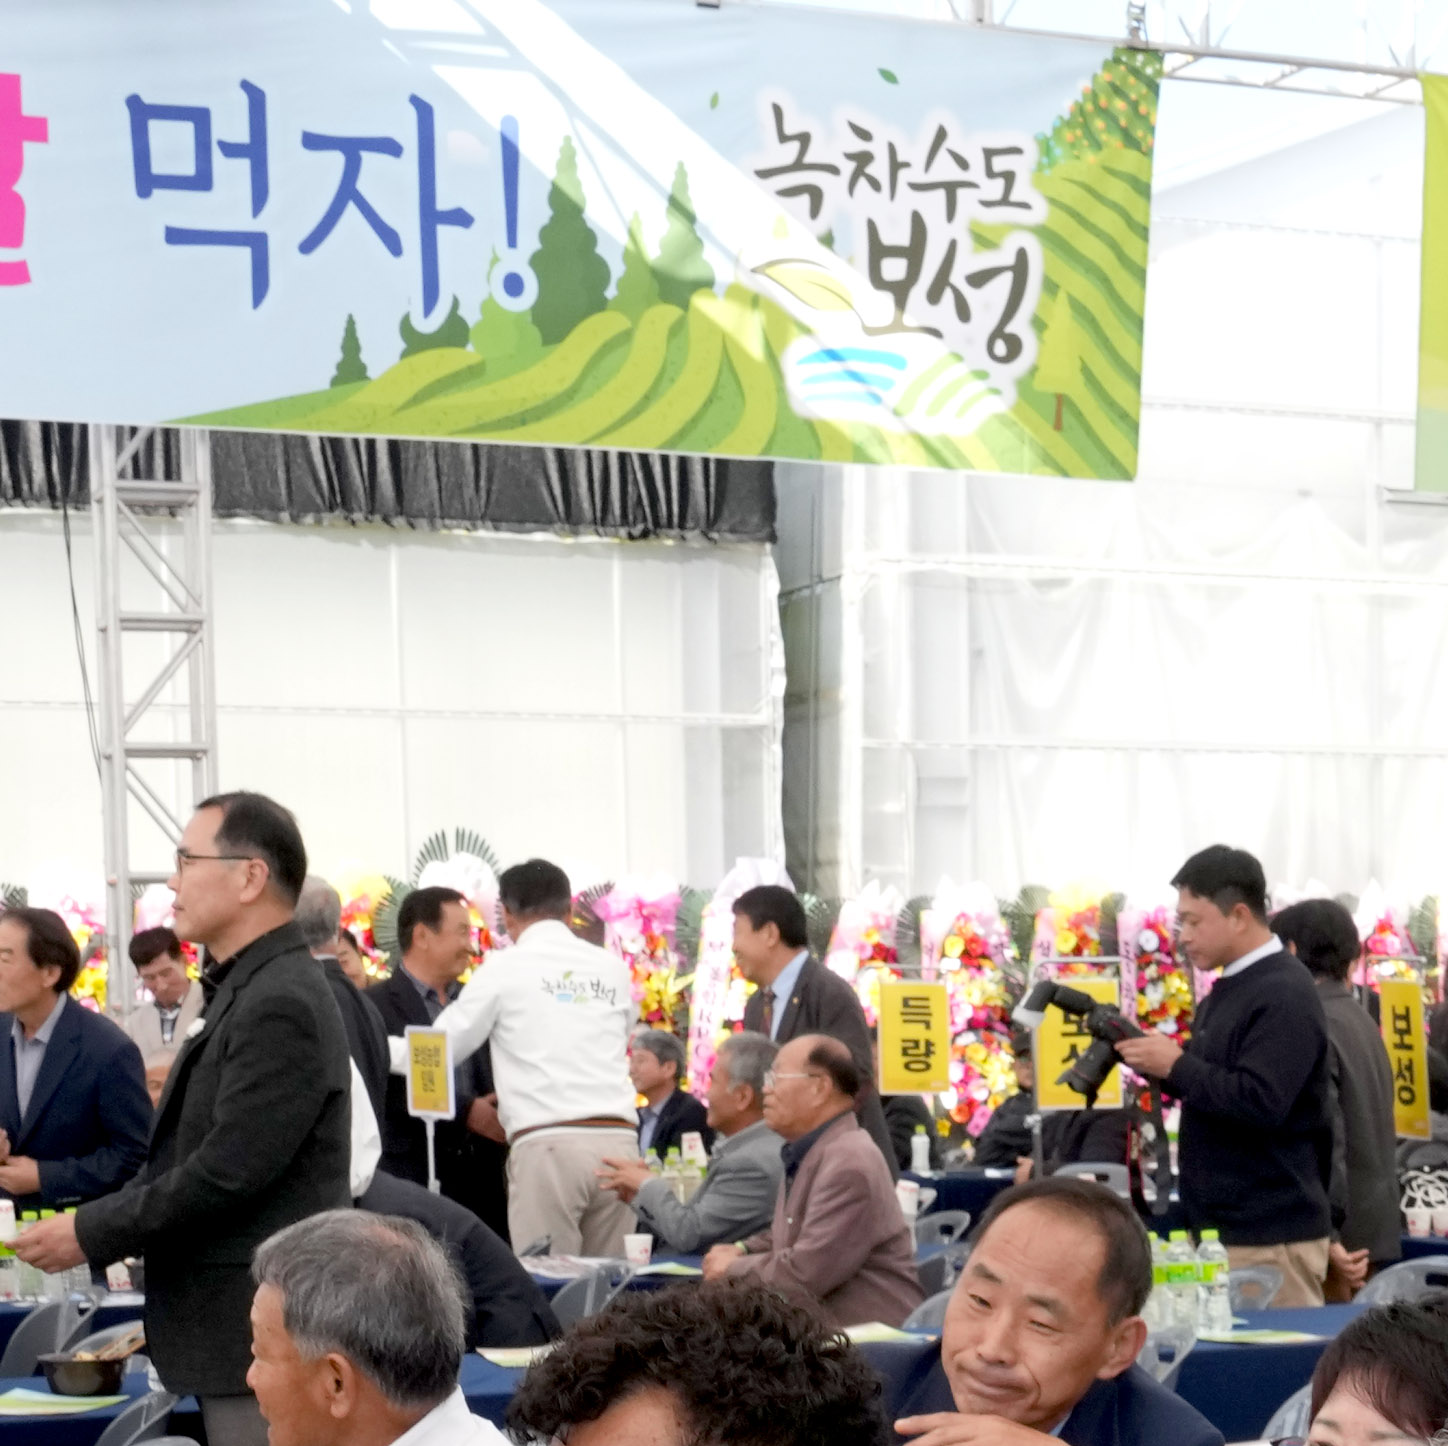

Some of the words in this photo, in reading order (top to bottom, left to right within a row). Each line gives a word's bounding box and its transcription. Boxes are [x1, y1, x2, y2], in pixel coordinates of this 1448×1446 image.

[125, 79, 527, 322] 먹자!
[754, 102, 1033, 223] 녹차수도
[862, 210, 1029, 363] 보성
[900, 995, 936, 1074] 득량
[1391, 1004, 1417, 1107] 보성
